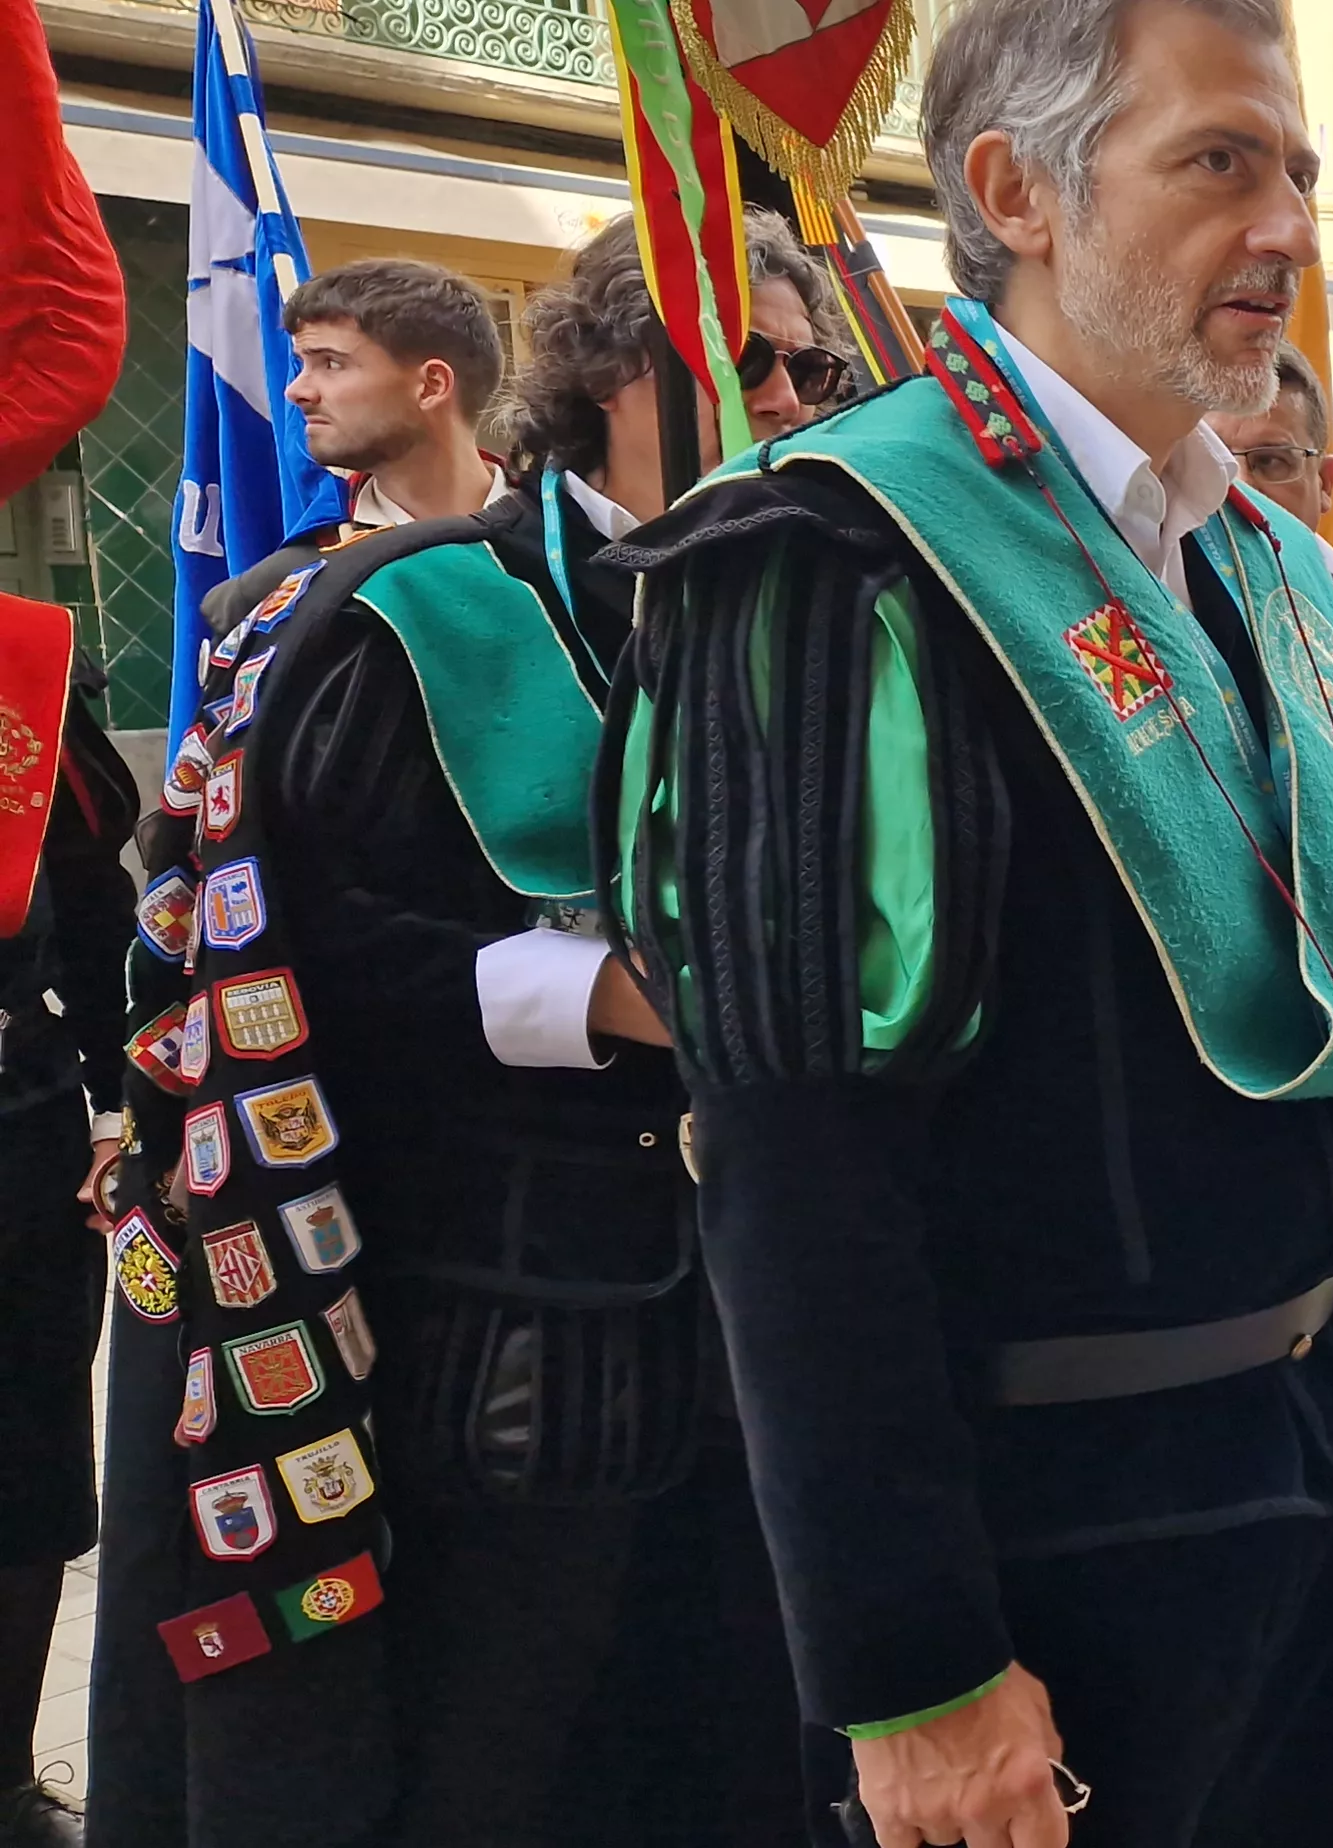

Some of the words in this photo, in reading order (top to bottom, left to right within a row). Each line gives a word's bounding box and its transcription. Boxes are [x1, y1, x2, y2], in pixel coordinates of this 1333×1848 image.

[257, 1090, 307, 1110] TOLEDO
[238, 1332, 294, 1355] NAVARRA
[295, 1441, 341, 1463] TRUJILLO
